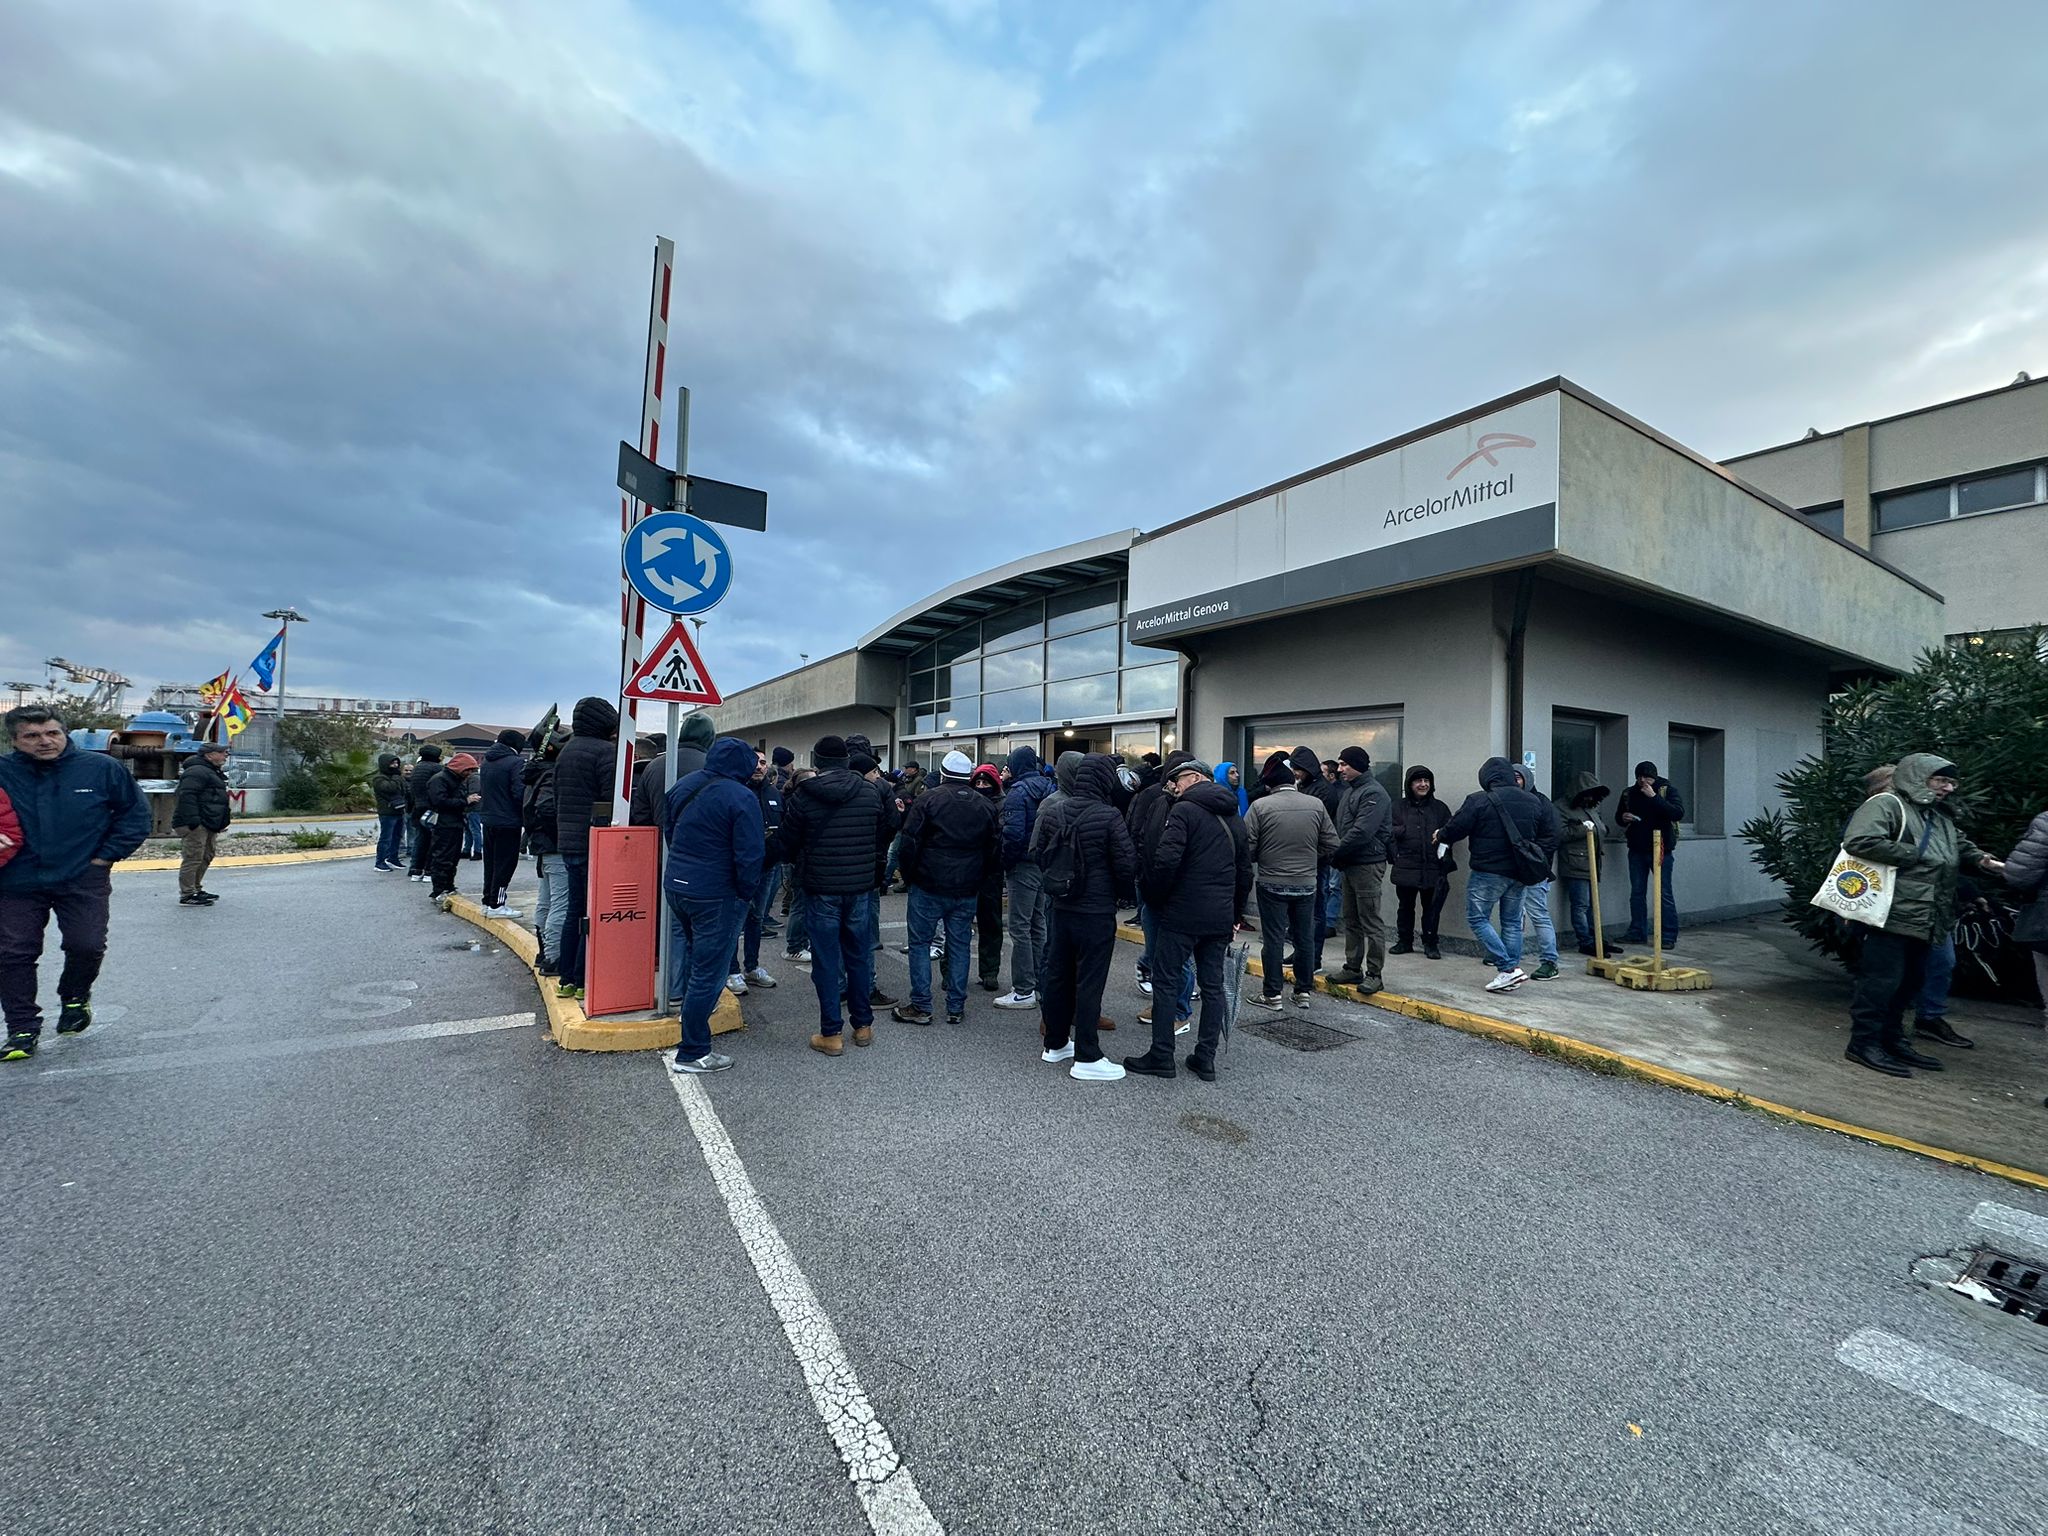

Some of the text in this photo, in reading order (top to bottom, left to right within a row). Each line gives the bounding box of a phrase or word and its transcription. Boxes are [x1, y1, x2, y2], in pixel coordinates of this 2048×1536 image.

[1383, 473, 1513, 529] ArcelorMittal
[1136, 600, 1229, 631] ArcelorMittal Genova
[1829, 860, 1882, 892] THE BULLDOG
[1825, 883, 1876, 911] AMSTERDAM
[600, 910, 646, 923] FAAC
